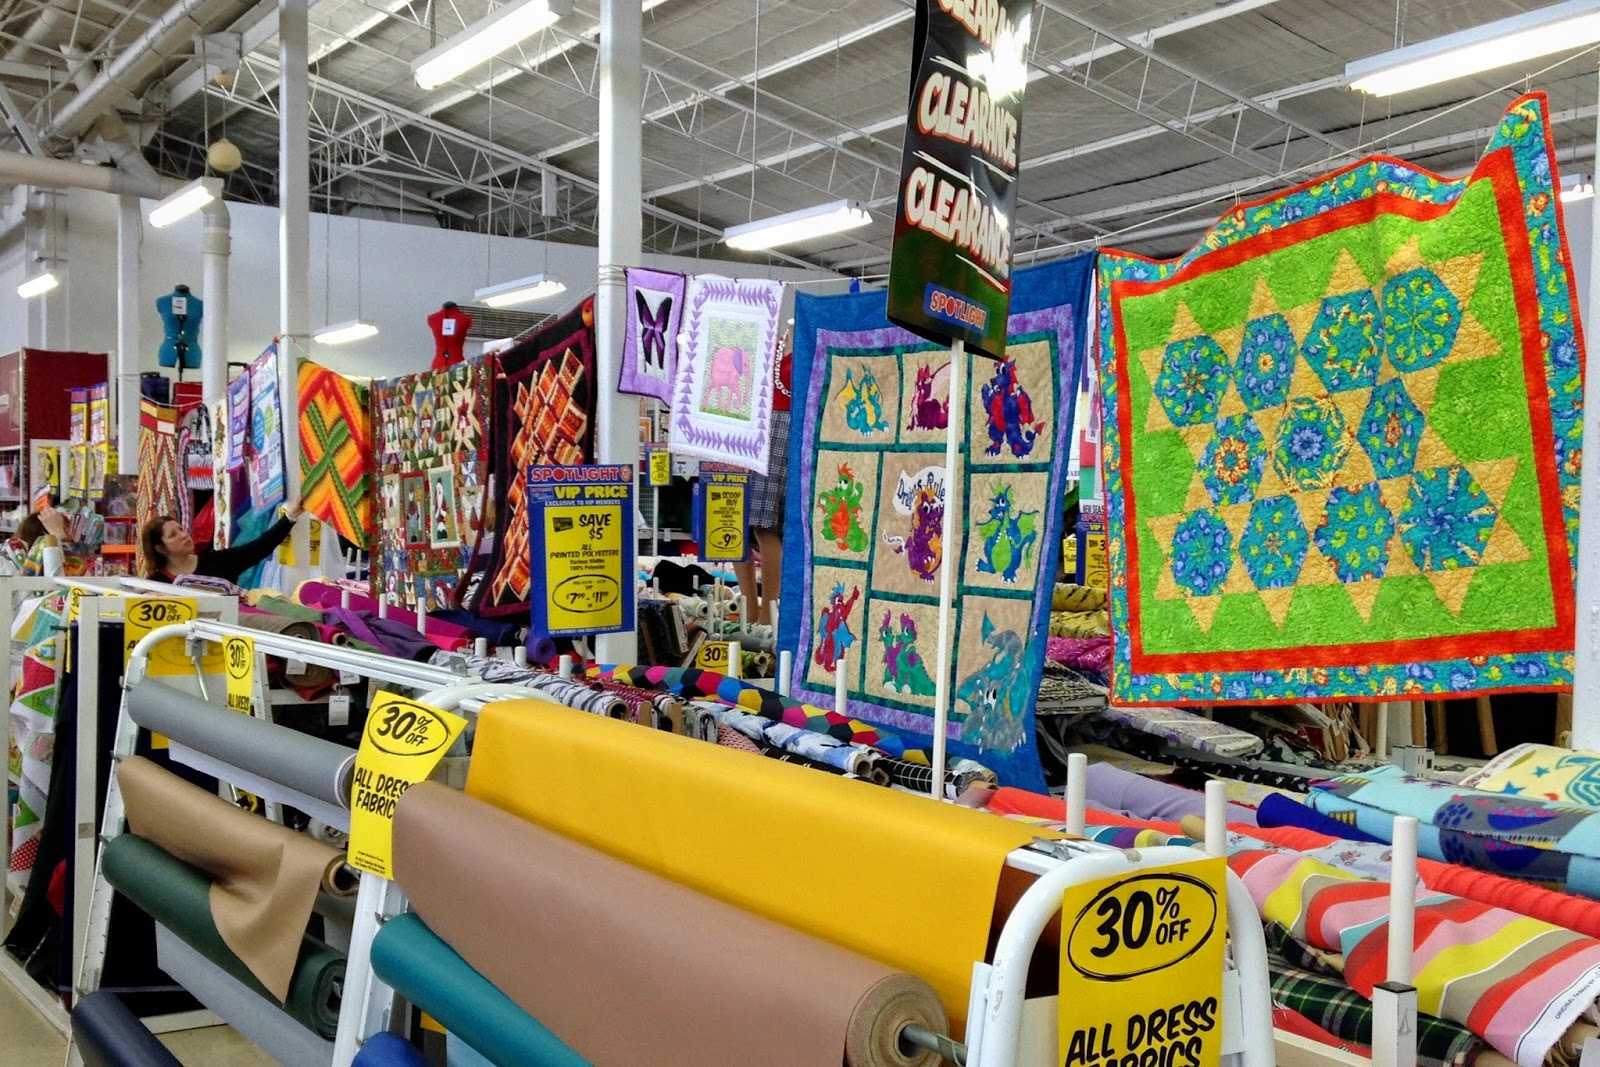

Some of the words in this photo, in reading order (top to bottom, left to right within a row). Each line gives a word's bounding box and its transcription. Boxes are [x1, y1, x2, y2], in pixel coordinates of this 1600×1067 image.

[917, 71, 1017, 170] CLEARANCE
[904, 166, 1011, 280] CLEARANCE
[930, 290, 987, 330] SPOTLIGHT
[531, 467, 619, 482] SPOTLIGHT
[712, 474, 726, 482] VIP
[726, 475, 748, 483] PRICE
[554, 486, 581, 499] VIP
[584, 486, 628, 499] PRICE
[579, 513, 611, 527] SAVE
[589, 527, 604, 540] $5
[582, 549, 619, 557] POLYESTERS
[166, 614, 182, 622] OFF
[405, 732, 429, 747] OFF
[354, 767, 373, 790] ALL
[375, 773, 414, 799] DRES
[356, 789, 396, 819] FABRIC
[1155, 918, 1191, 945] OFF
[1065, 1022, 1115, 1067] ALL
[1126, 996, 1218, 1051] DRESS
[1089, 1036, 1202, 1067] RICS
